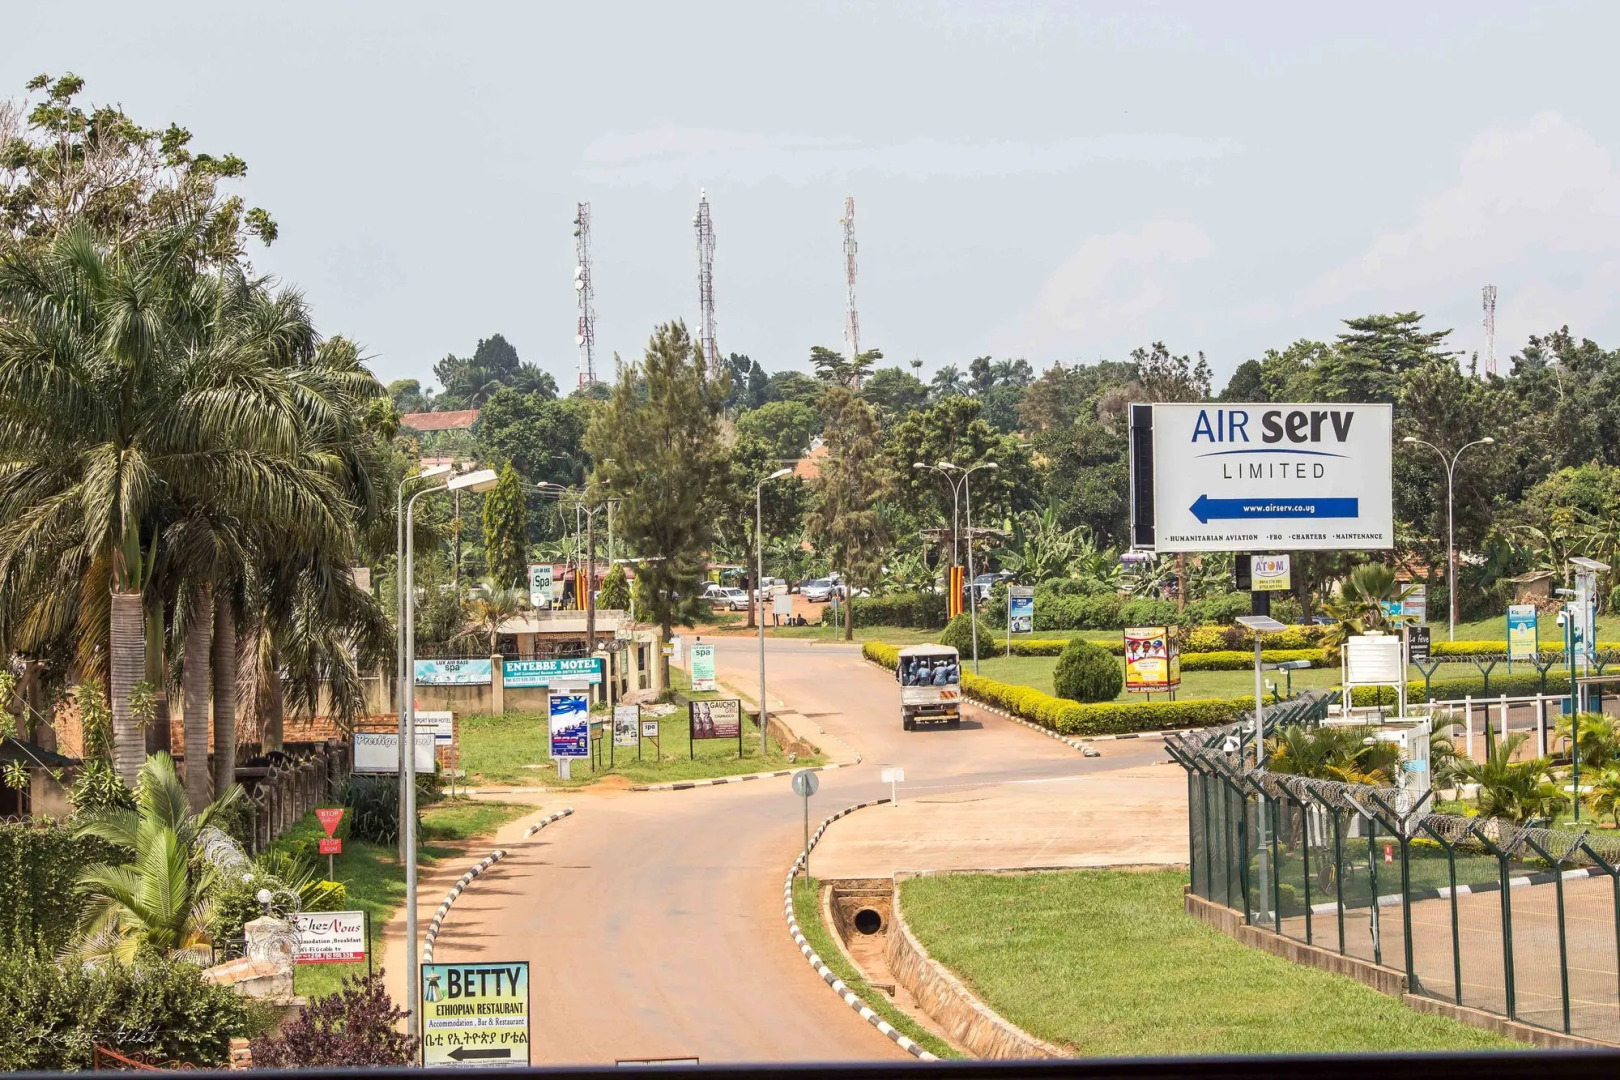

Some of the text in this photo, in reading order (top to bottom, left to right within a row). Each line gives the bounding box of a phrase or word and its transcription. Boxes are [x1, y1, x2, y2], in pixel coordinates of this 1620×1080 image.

[1191, 409, 1355, 443] AIR serv
[1223, 463, 1325, 479] LIMITED
[1243, 503, 1315, 513] www.airserv.co.ug
[1255, 560, 1284, 571] ATOM
[535, 575, 550, 590] Spa
[445, 664, 460, 673] spa
[506, 659, 598, 672] ENTEBBE MOTEL
[356, 735, 397, 748] Prestige
[447, 966, 522, 999] BETTY
[436, 1002, 524, 1016] ETHIOPIAN RESTAURANT
[428, 1018, 474, 1028] Accommodation
[478, 1018, 487, 1026] Bar
[488, 1018, 494, 1026] &
[495, 1018, 524, 1026] Restaurant
